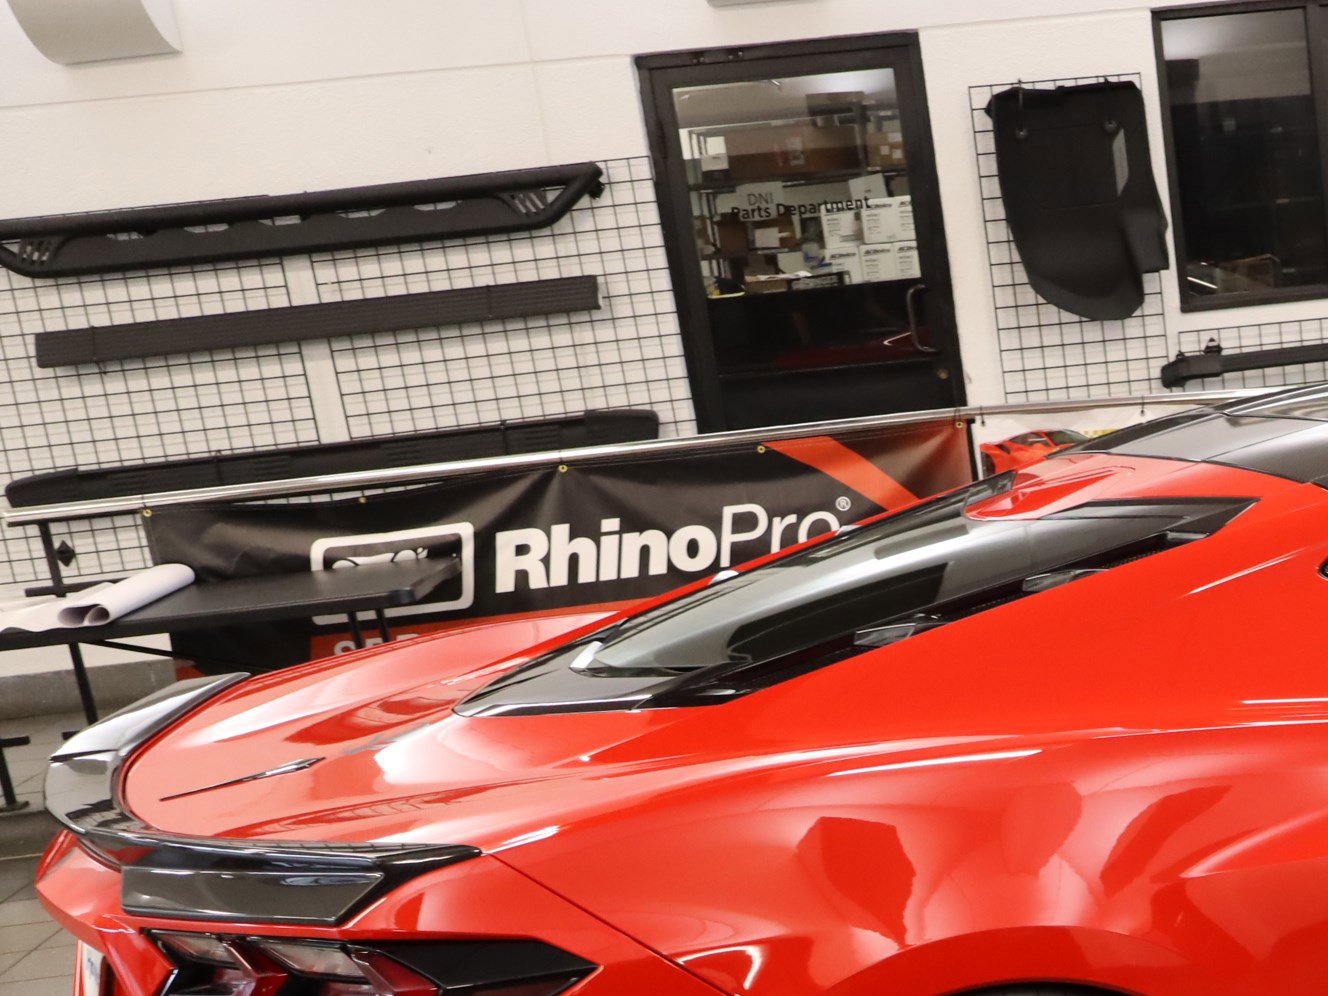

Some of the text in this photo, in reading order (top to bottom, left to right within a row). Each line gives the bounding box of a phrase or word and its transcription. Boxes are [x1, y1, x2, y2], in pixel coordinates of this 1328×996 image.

[731, 195, 871, 220] Parts Department
[747, 192, 774, 206] DNI
